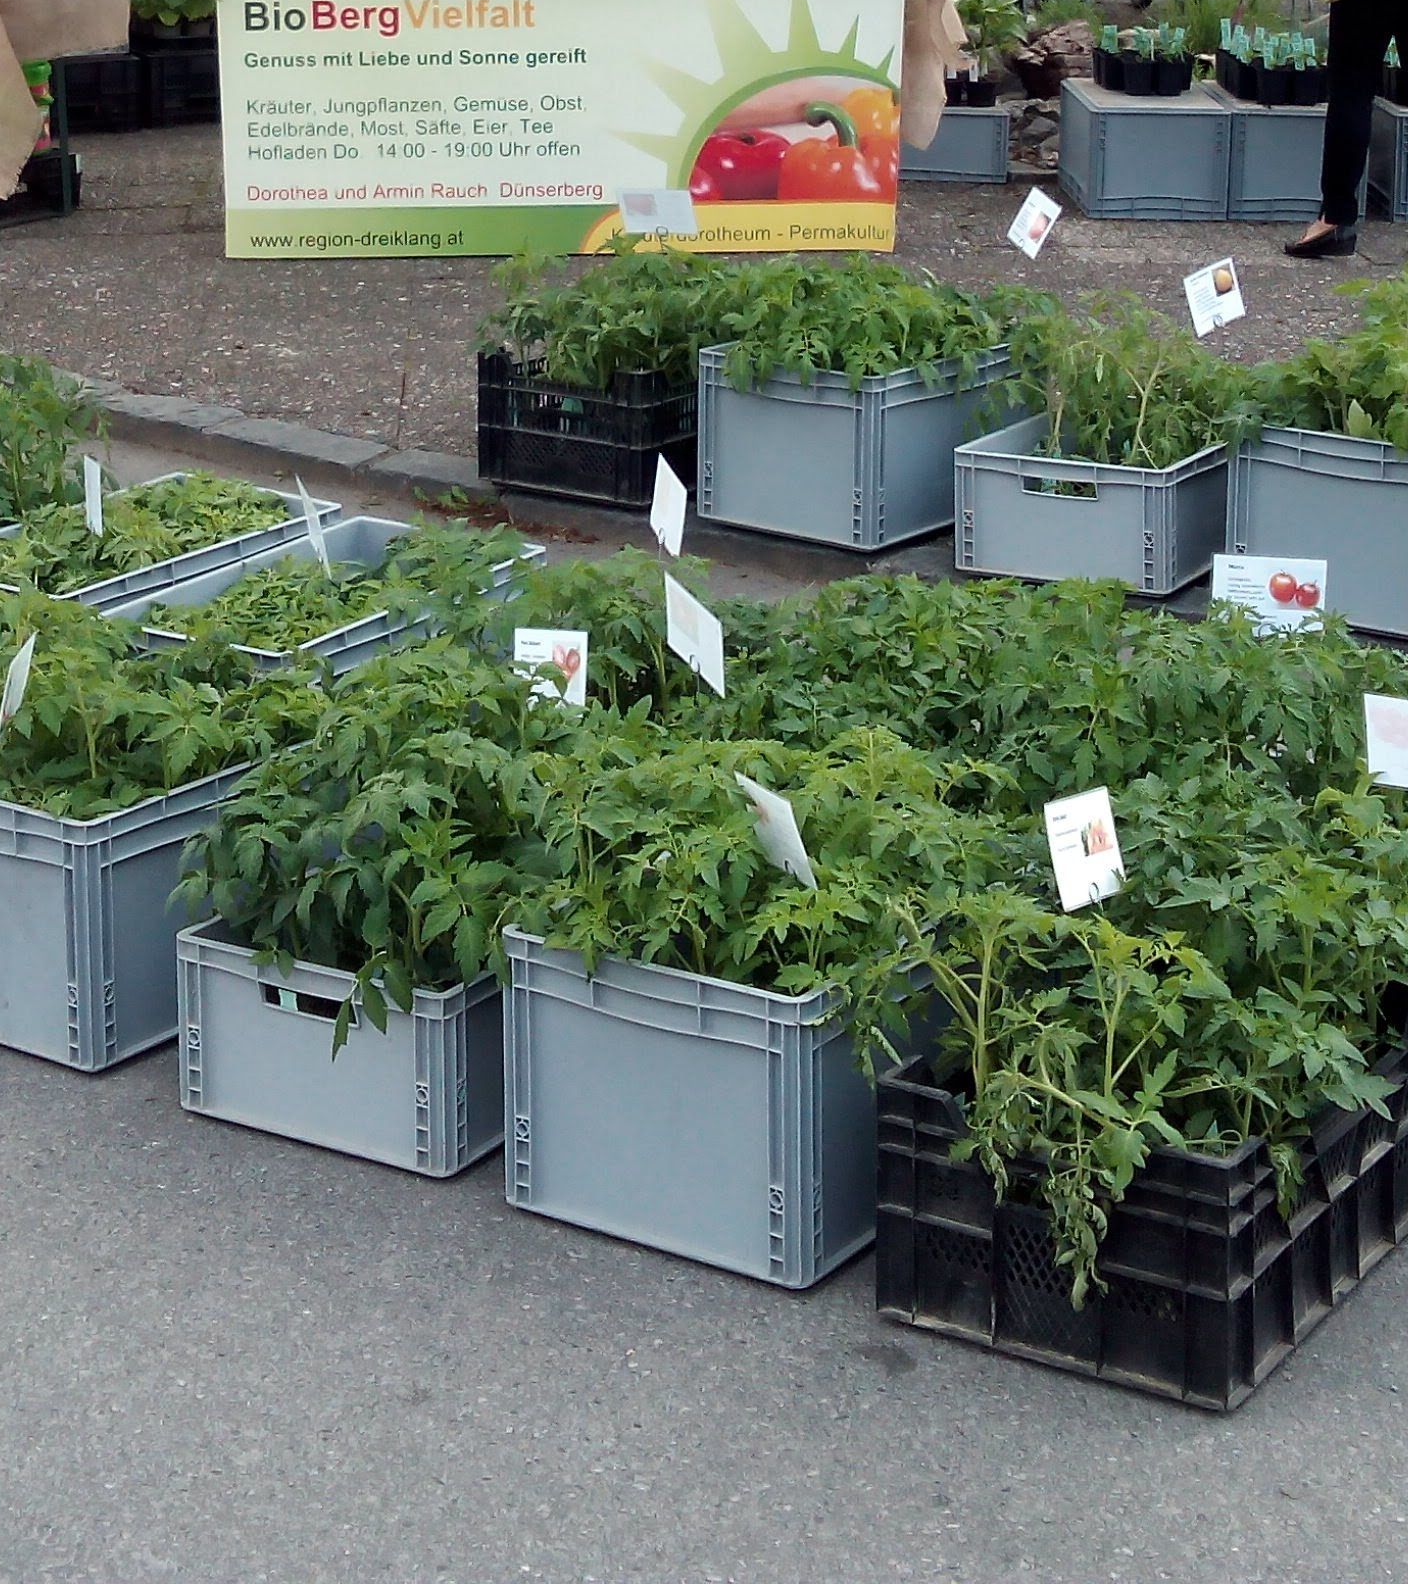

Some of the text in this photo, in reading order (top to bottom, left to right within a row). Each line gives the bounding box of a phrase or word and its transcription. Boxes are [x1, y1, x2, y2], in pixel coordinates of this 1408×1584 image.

[244, 47, 587, 68] Genuss mit Liebe und Sonne gereift
[247, 99, 317, 116] Kräuter,
[323, 97, 447, 117] Jungpflanzen,
[453, 96, 534, 114] Gemüse,
[247, 122, 354, 140] Edelbrände,
[520, 118, 554, 135] Tee
[248, 144, 327, 161] Hofladen
[444, 142, 493, 158] 19:00
[499, 141, 530, 157] Uhr
[536, 140, 580, 157] offen
[247, 181, 604, 201] Dorothea und Armin Rauch Dünserberg
[789, 222, 890, 241] Permakultur
